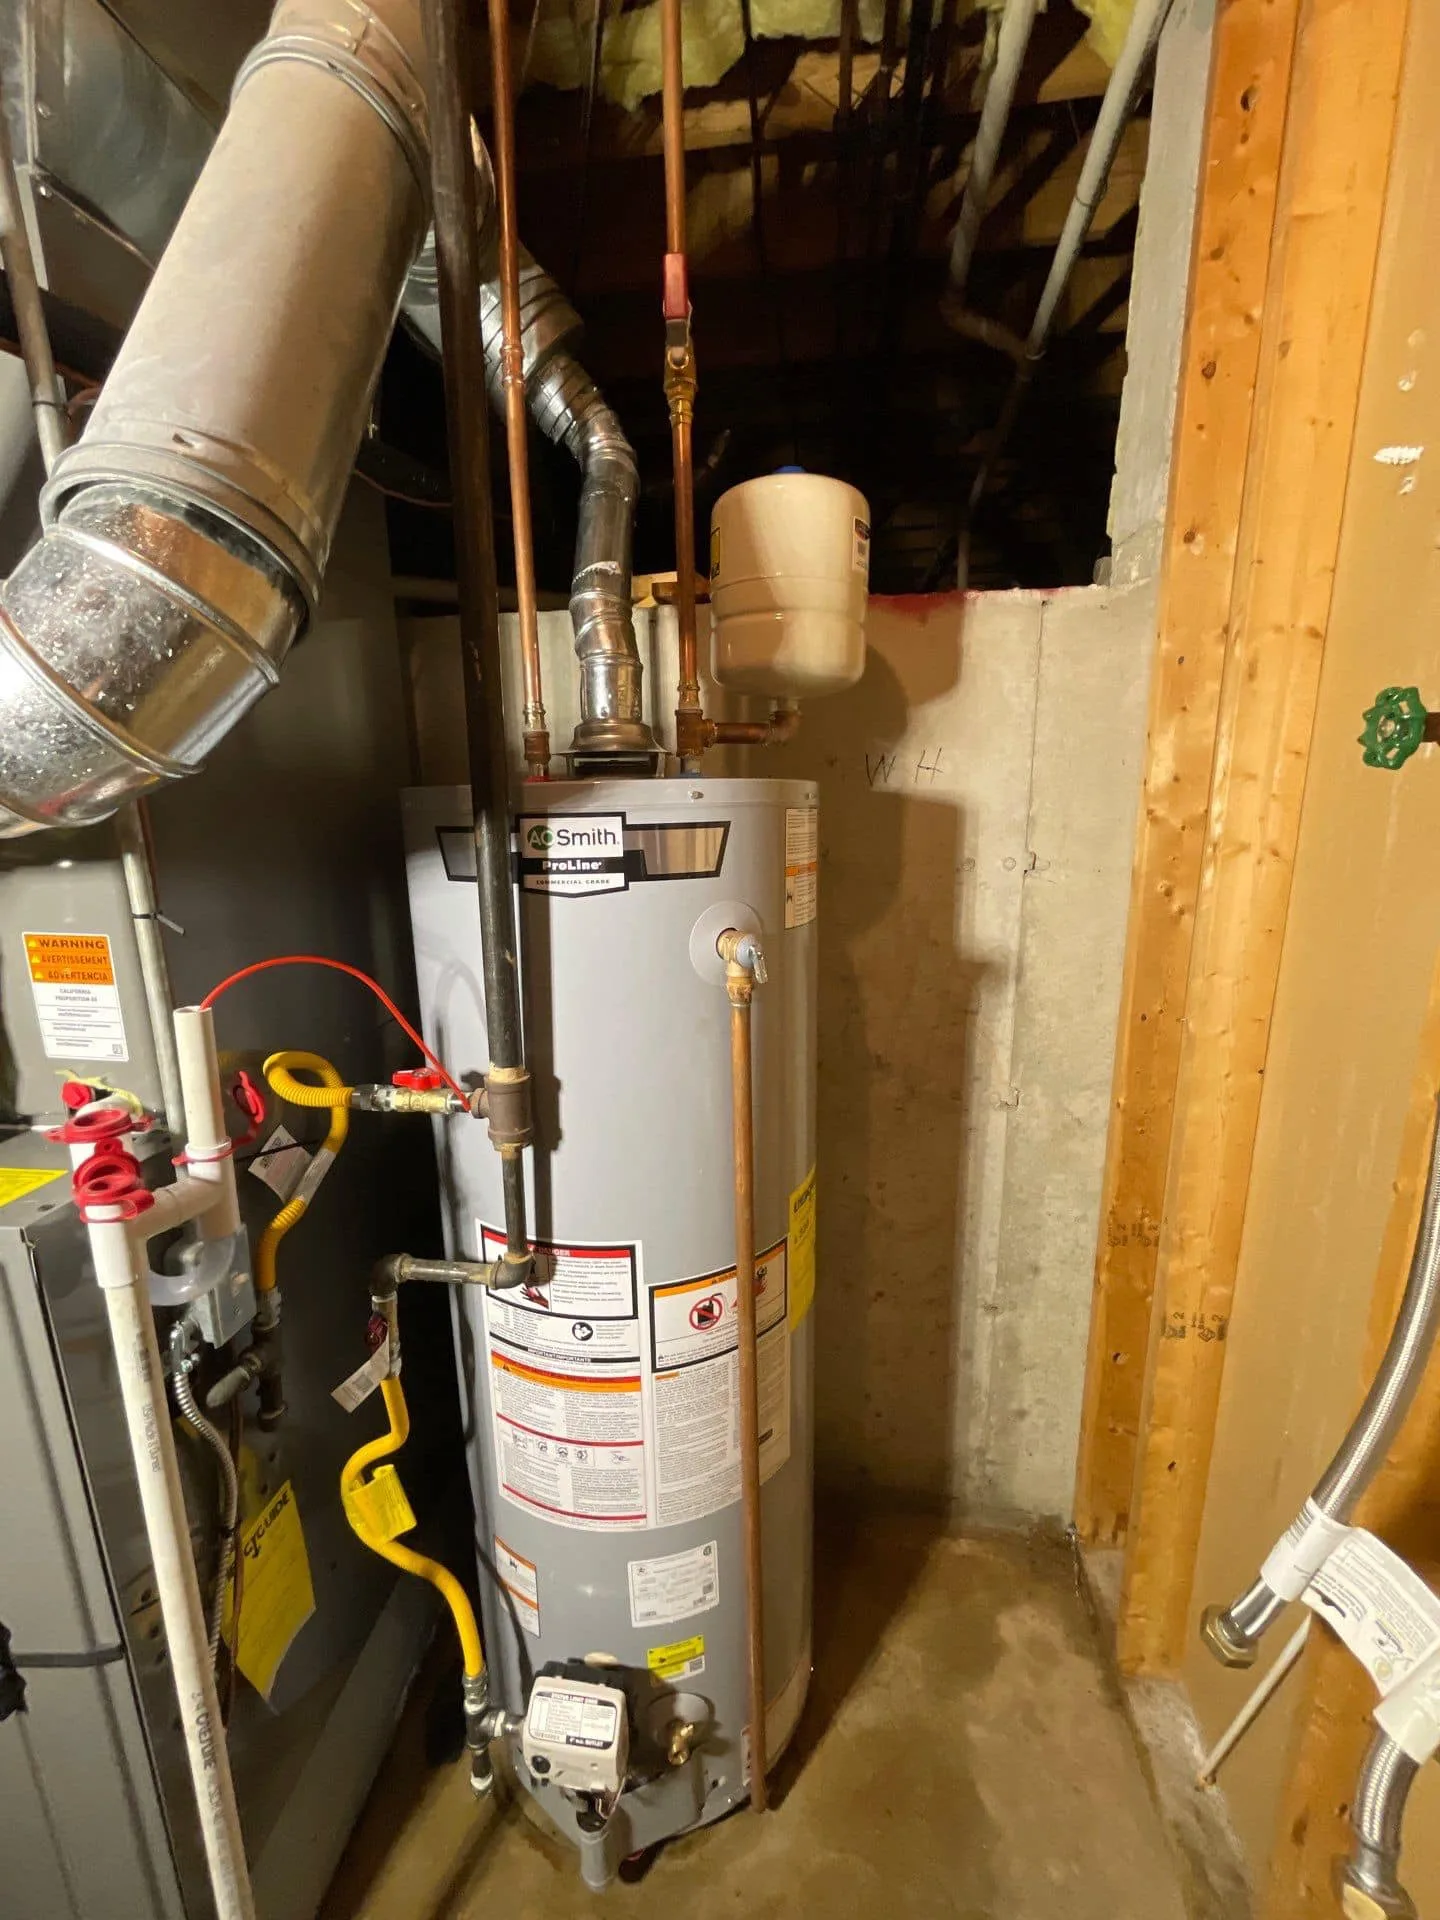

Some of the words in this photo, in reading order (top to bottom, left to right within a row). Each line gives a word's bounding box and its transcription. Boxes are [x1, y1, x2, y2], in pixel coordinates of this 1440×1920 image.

[556, 828, 617, 846] Smith
[542, 859, 602, 871] ProLine
[39, 939, 105, 950] WARNING
